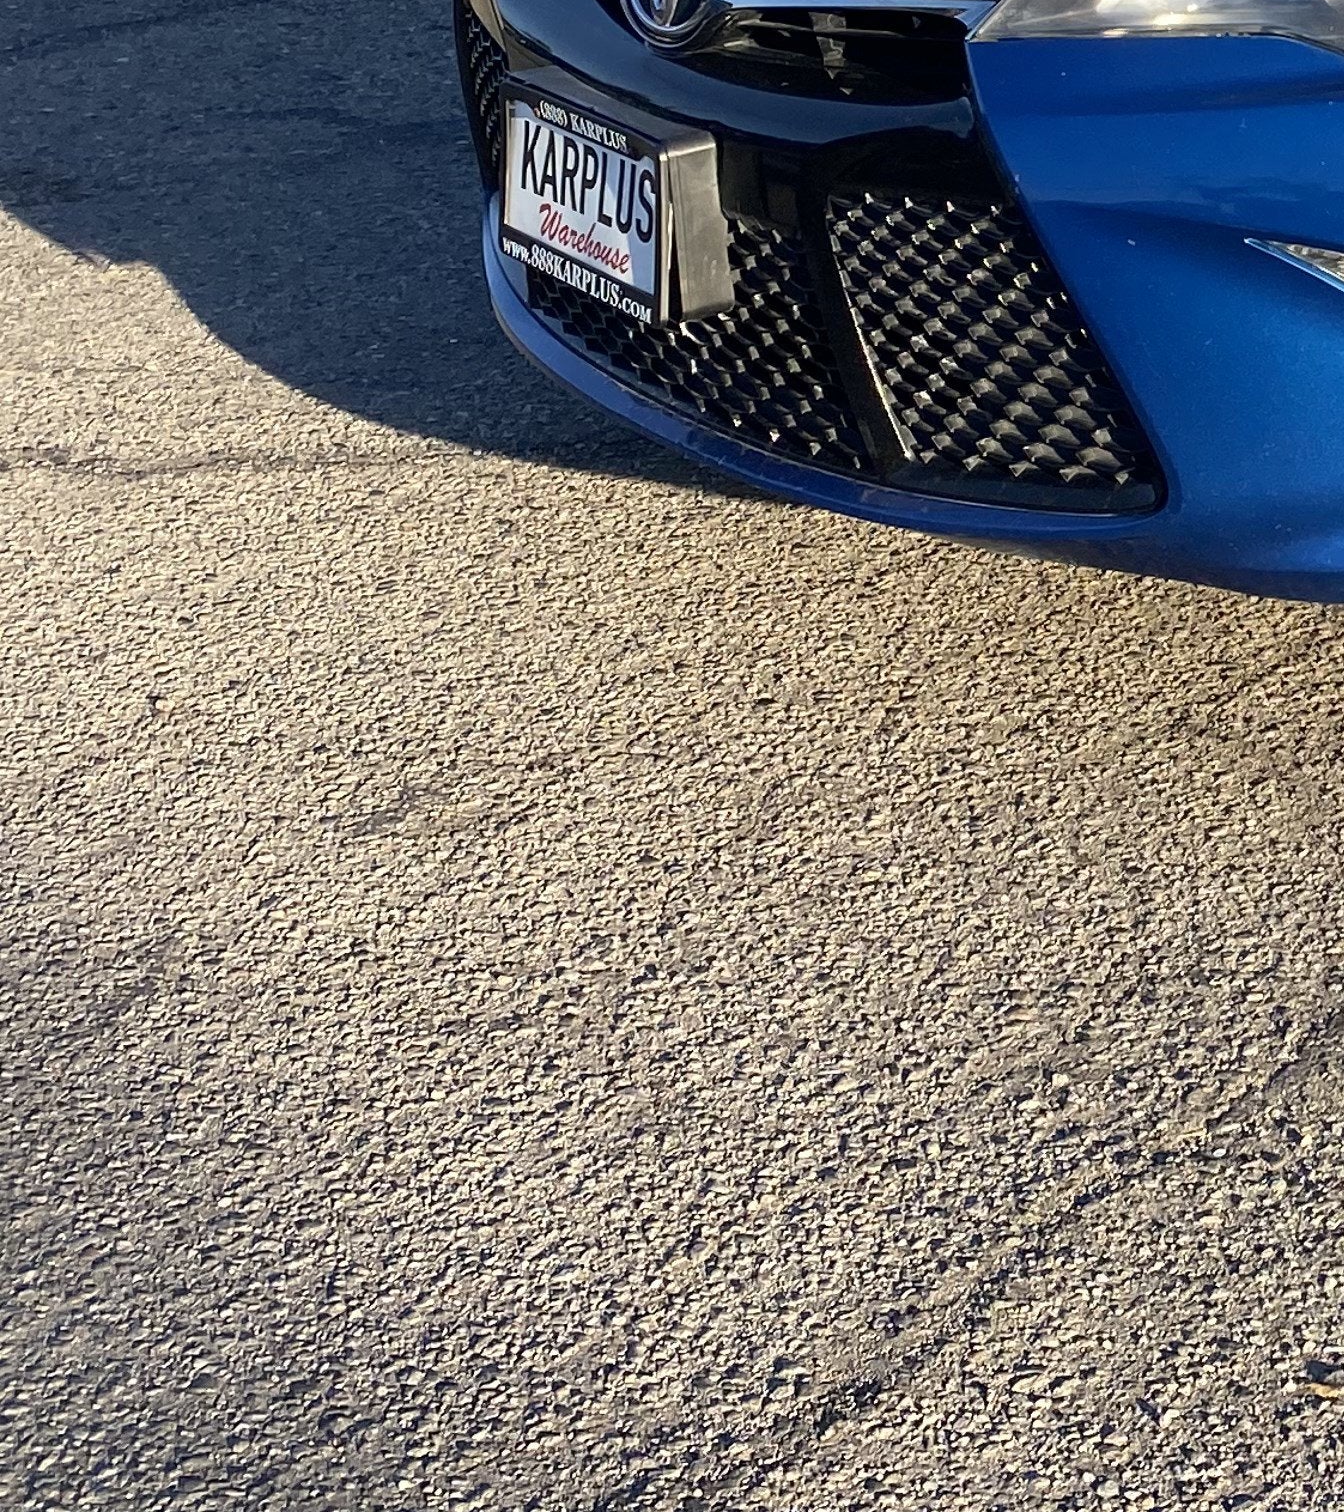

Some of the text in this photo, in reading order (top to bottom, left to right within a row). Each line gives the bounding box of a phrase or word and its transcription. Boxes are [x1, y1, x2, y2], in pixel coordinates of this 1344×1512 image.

[539, 100, 627, 151] (888) KARPLUS
[521, 120, 656, 243] KARPLUS
[539, 203, 631, 274] Warehouse
